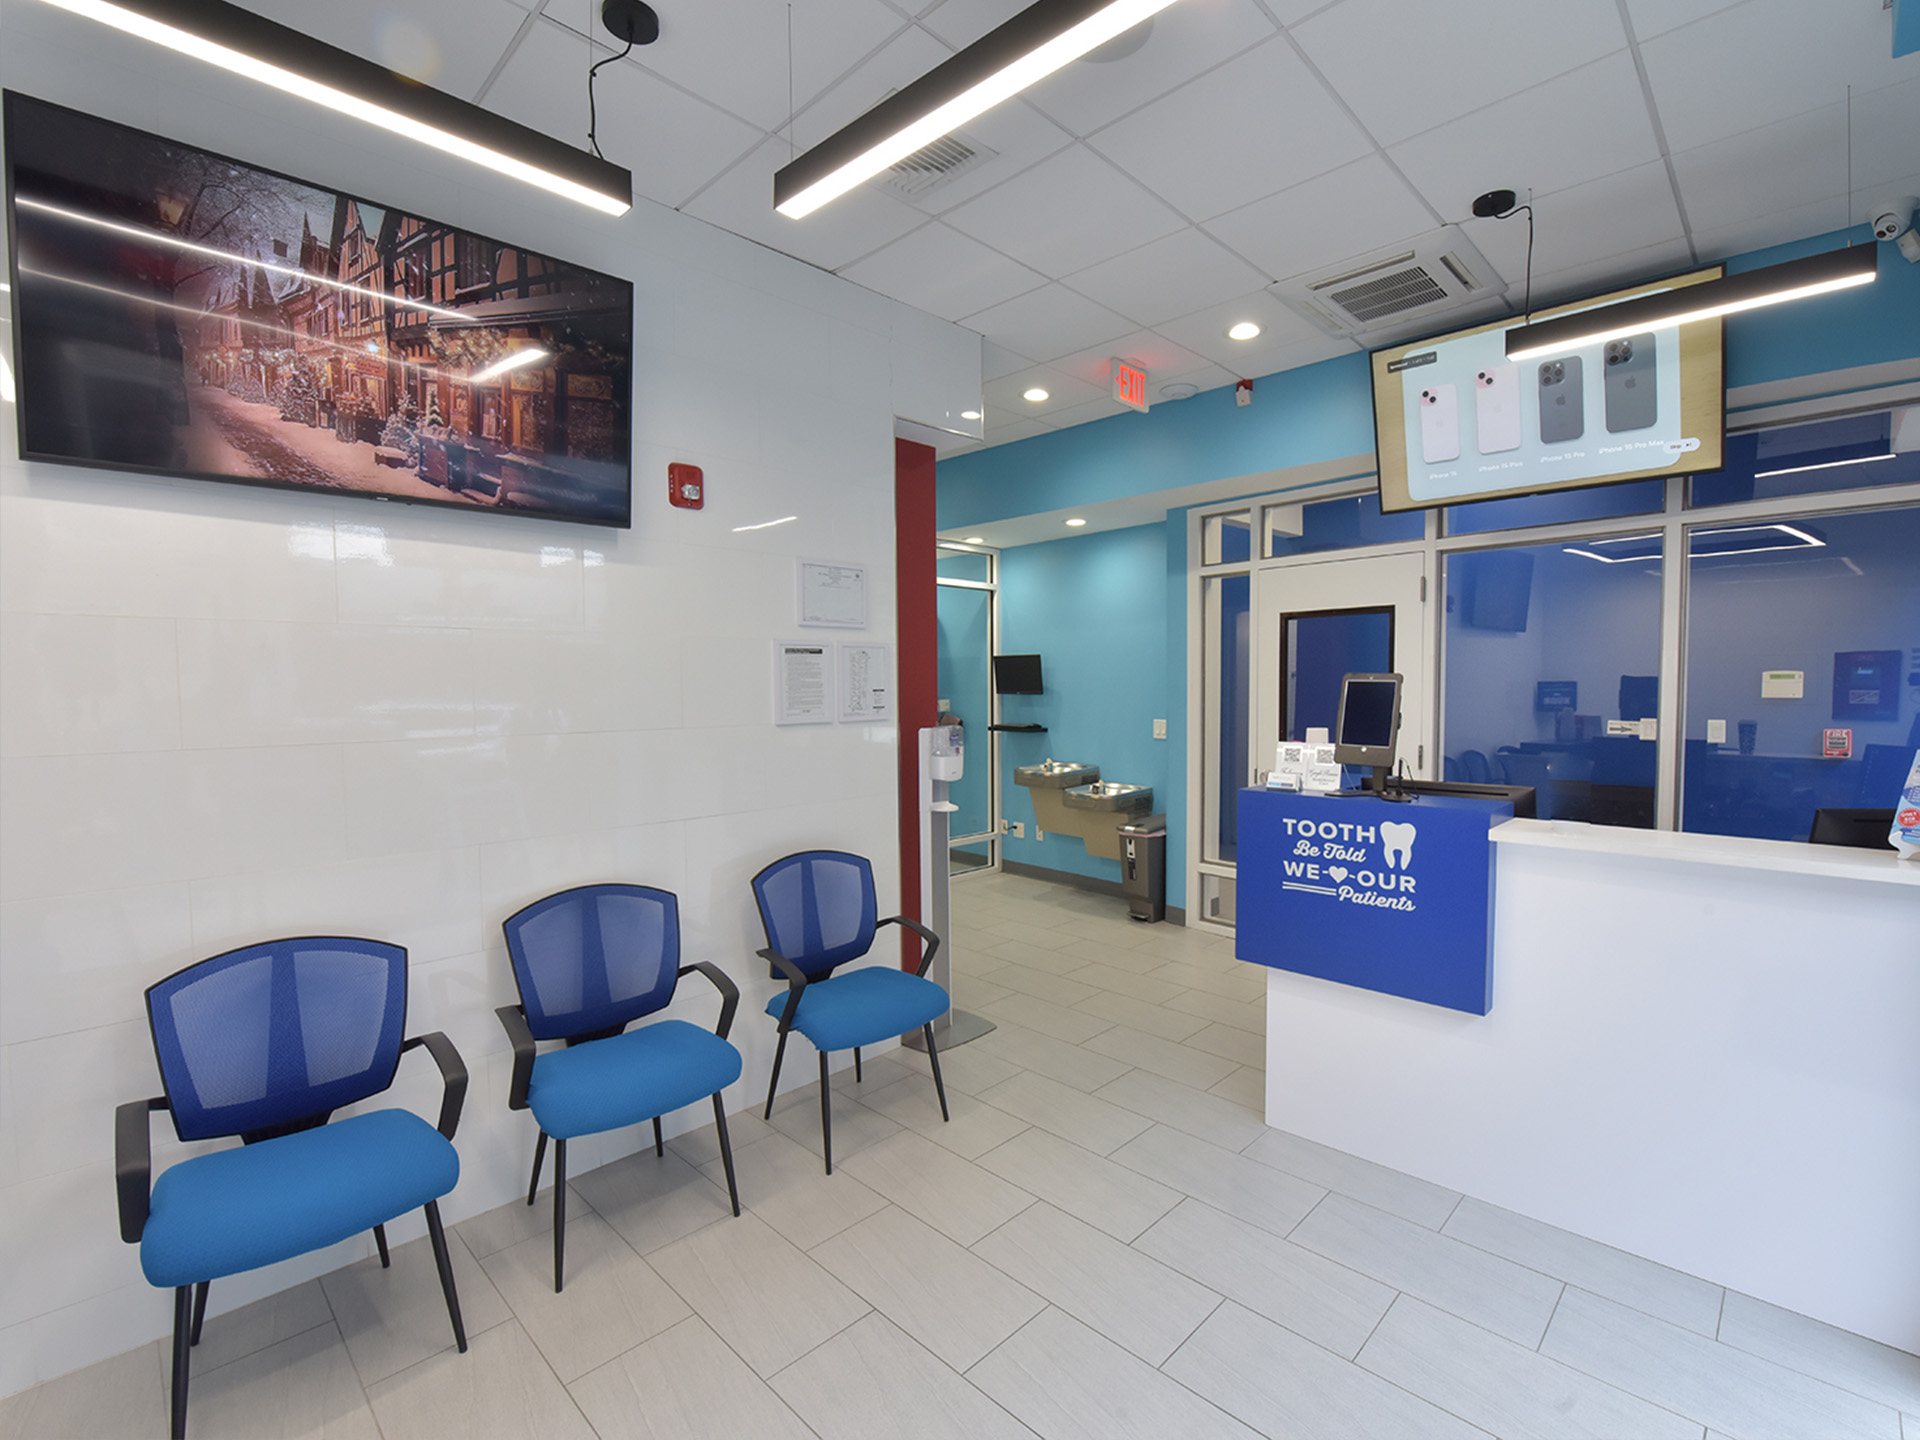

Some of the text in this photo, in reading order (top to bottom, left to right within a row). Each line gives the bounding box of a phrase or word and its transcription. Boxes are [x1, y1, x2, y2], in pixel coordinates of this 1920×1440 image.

[1119, 364, 1146, 407] EXIT
[1598, 446, 1622, 455] iPhone
[1634, 441, 1648, 449] Pro
[1648, 439, 1665, 447] Max
[1282, 818, 1376, 844] TOOTH
[1293, 839, 1367, 863] Be Told
[1283, 860, 1417, 893] WE OUR
[1338, 885, 1416, 912] Patients
